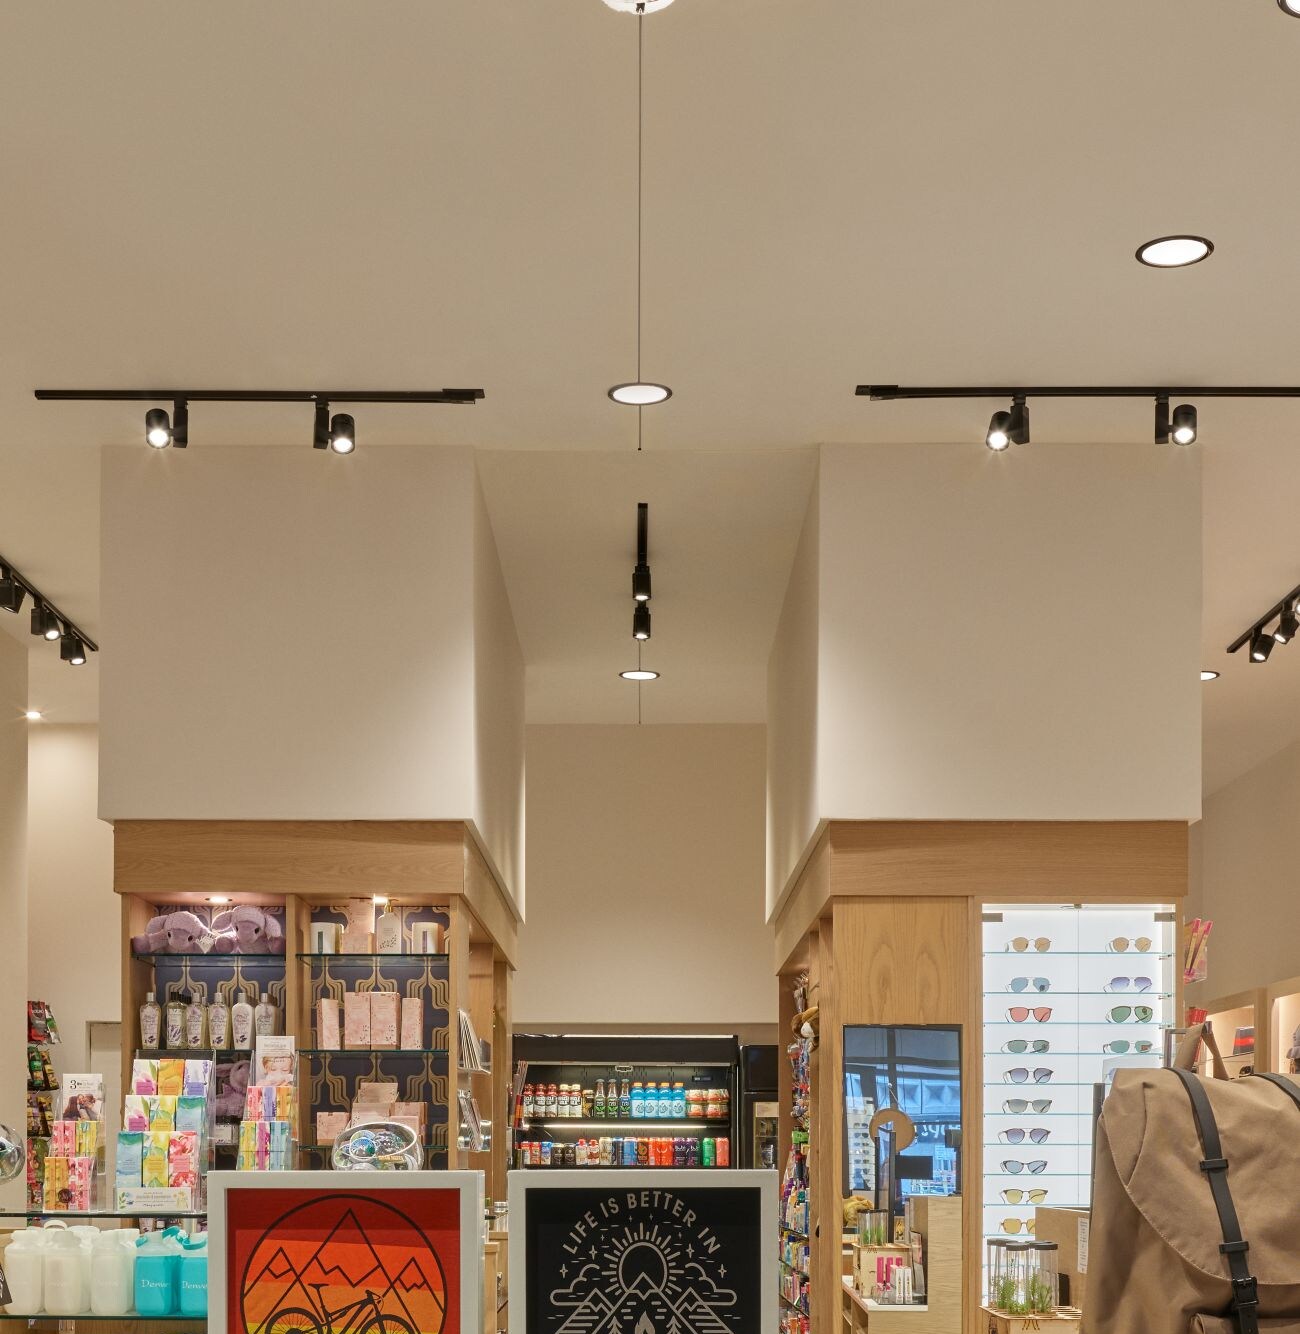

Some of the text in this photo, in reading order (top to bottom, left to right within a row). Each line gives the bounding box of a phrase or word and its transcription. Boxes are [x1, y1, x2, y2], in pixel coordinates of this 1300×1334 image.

[562, 1191, 721, 1254] LIFE IS BETTER IN
